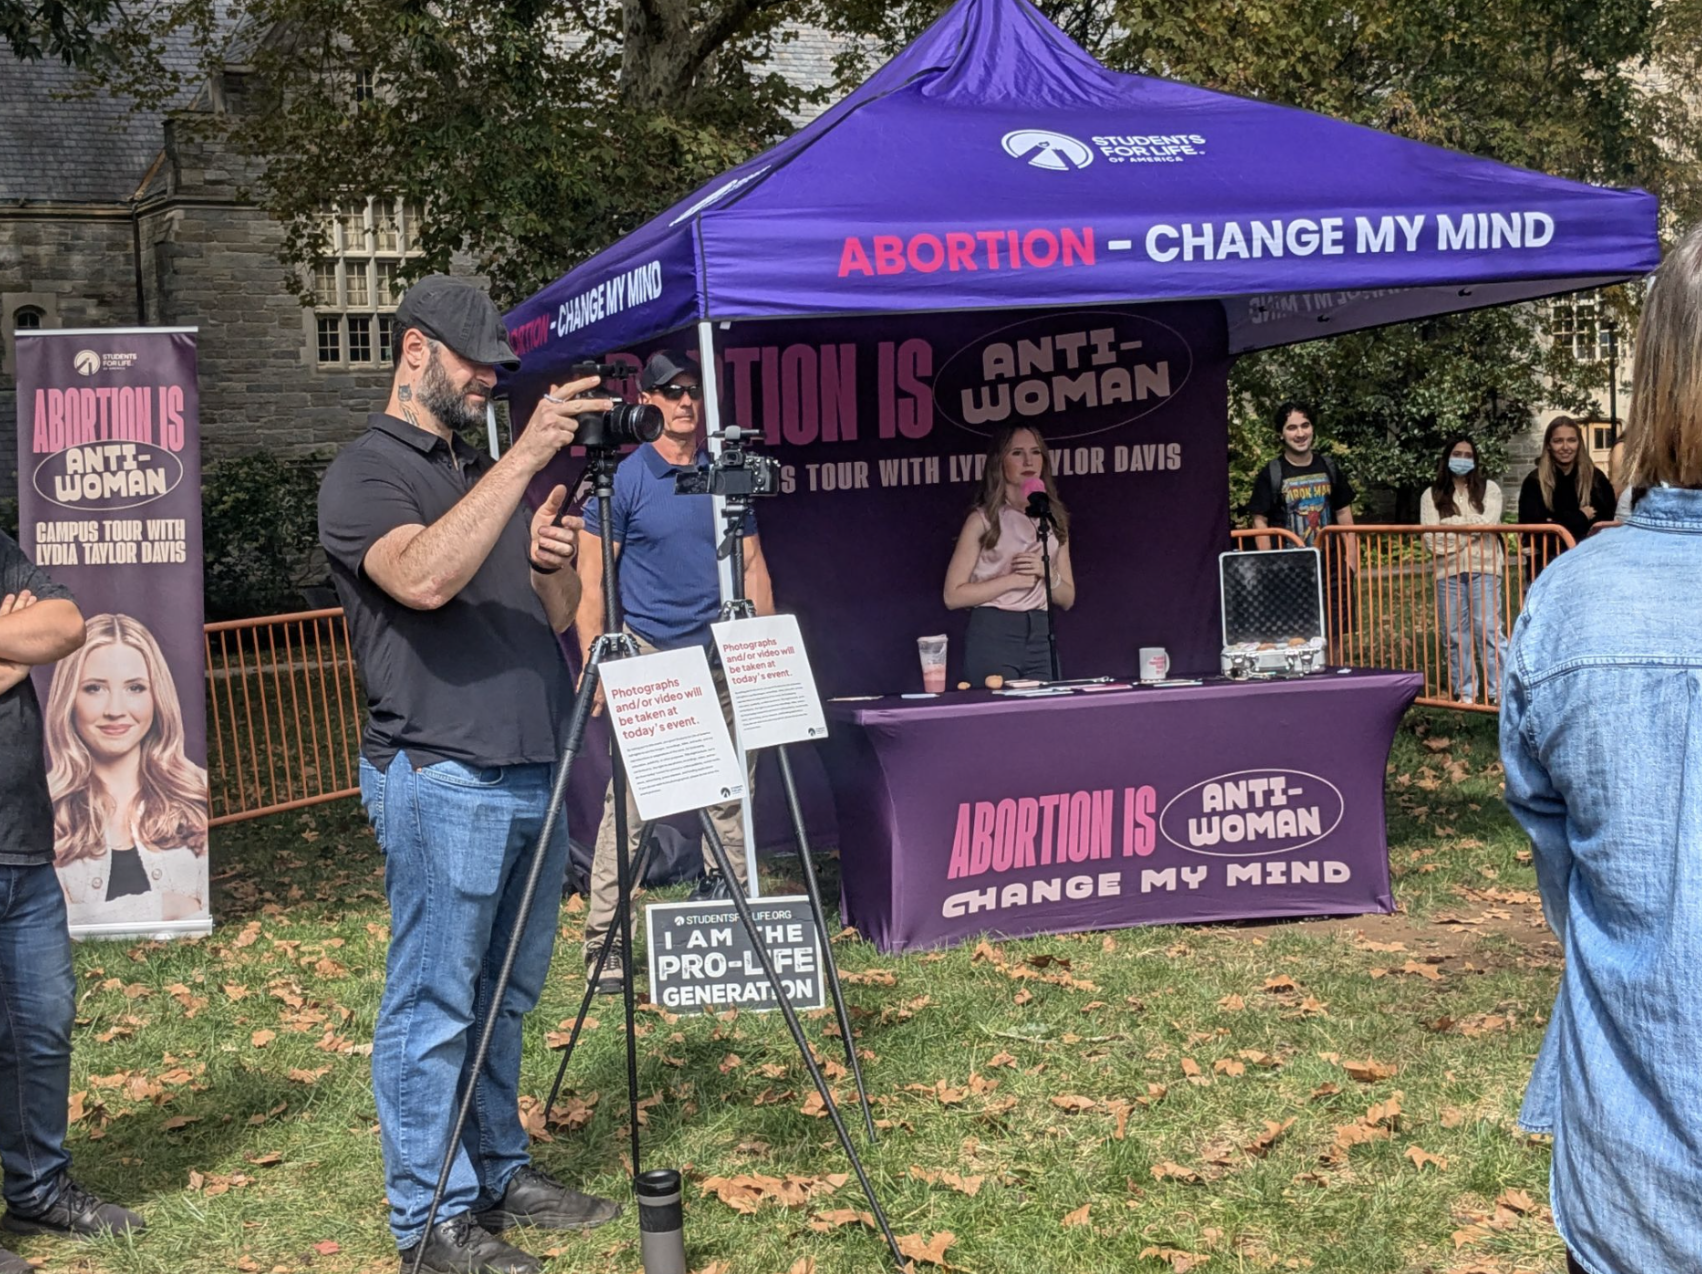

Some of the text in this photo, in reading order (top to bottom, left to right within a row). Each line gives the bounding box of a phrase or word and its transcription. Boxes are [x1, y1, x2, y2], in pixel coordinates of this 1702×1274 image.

[1092, 134, 1206, 147] STUDENTS
[1100, 146, 1154, 157] FOR
[838, 227, 1095, 278] ABORTION
[1145, 217, 1344, 263] CHANGE
[1355, 214, 1426, 254] MY
[1436, 211, 1557, 250] MIND
[510, 313, 549, 356] ORTION
[557, 284, 605, 337] CHANGE
[606, 274, 626, 316] MY
[627, 260, 662, 308] MIND
[982, 327, 1142, 381] ANTI-
[878, 338, 934, 440] IS
[961, 361, 1171, 425] WOMAN
[33, 385, 185, 453] ABORTION IS
[66, 444, 151, 474] ANTI-
[805, 461, 869, 491] TOUR
[878, 458, 940, 487] WITH
[949, 454, 987, 482] LYD
[1049, 447, 1105, 476] YLOR
[1114, 442, 1181, 472] DAVIS
[54, 468, 166, 502] WOMAN
[36, 519, 186, 543] CAMPUS TOUR WITH
[36, 540, 186, 566] LYDIA TAYLOR DAVIS
[723, 637, 777, 653] Photographs
[726, 646, 796, 663] and/or video will
[729, 660, 776, 674] be taken at
[767, 669, 793, 679] event.
[611, 680, 680, 698] Photographs
[616, 686, 703, 712] and/or video will
[619, 706, 678, 727] be taken at
[667, 717, 699, 729] event.
[1203, 776, 1303, 813] ANTI-
[948, 785, 1156, 880] ABORTION IS
[1188, 806, 1321, 847] WOMAN
[942, 860, 1352, 919] CHANGE MY MIND
[686, 910, 792, 925] STUDENTSFLIFE.ORG
[665, 924, 803, 950] I AM HE
[659, 948, 814, 980] PRO-LFE
